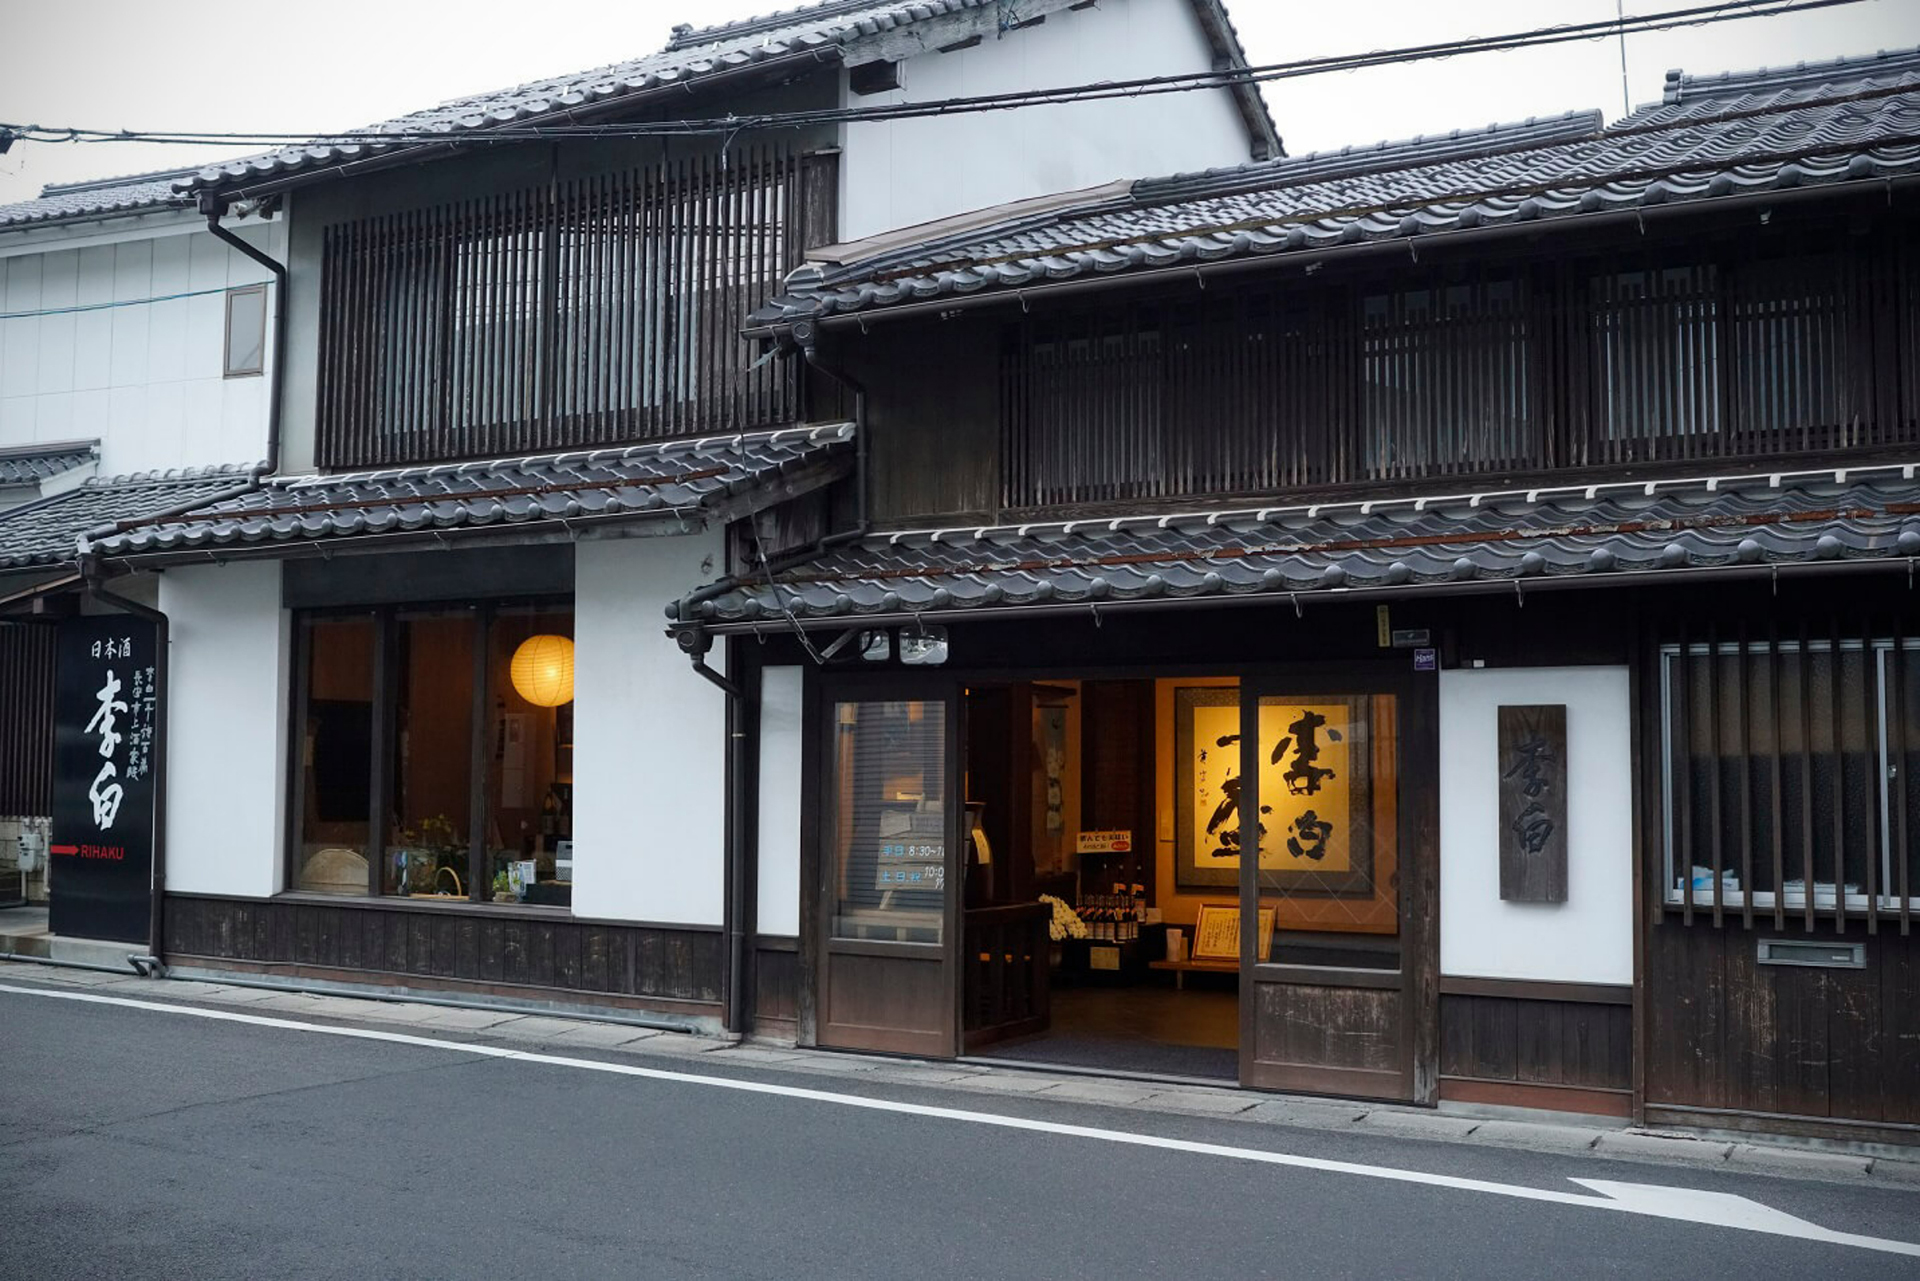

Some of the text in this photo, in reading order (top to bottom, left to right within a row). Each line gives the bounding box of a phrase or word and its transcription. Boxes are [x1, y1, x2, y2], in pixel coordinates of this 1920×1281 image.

[91, 637, 131, 660] 日本酒
[84, 669, 128, 831] 李白
[1503, 734, 1556, 855] 李白
[80, 844, 124, 860] RIHAKU
